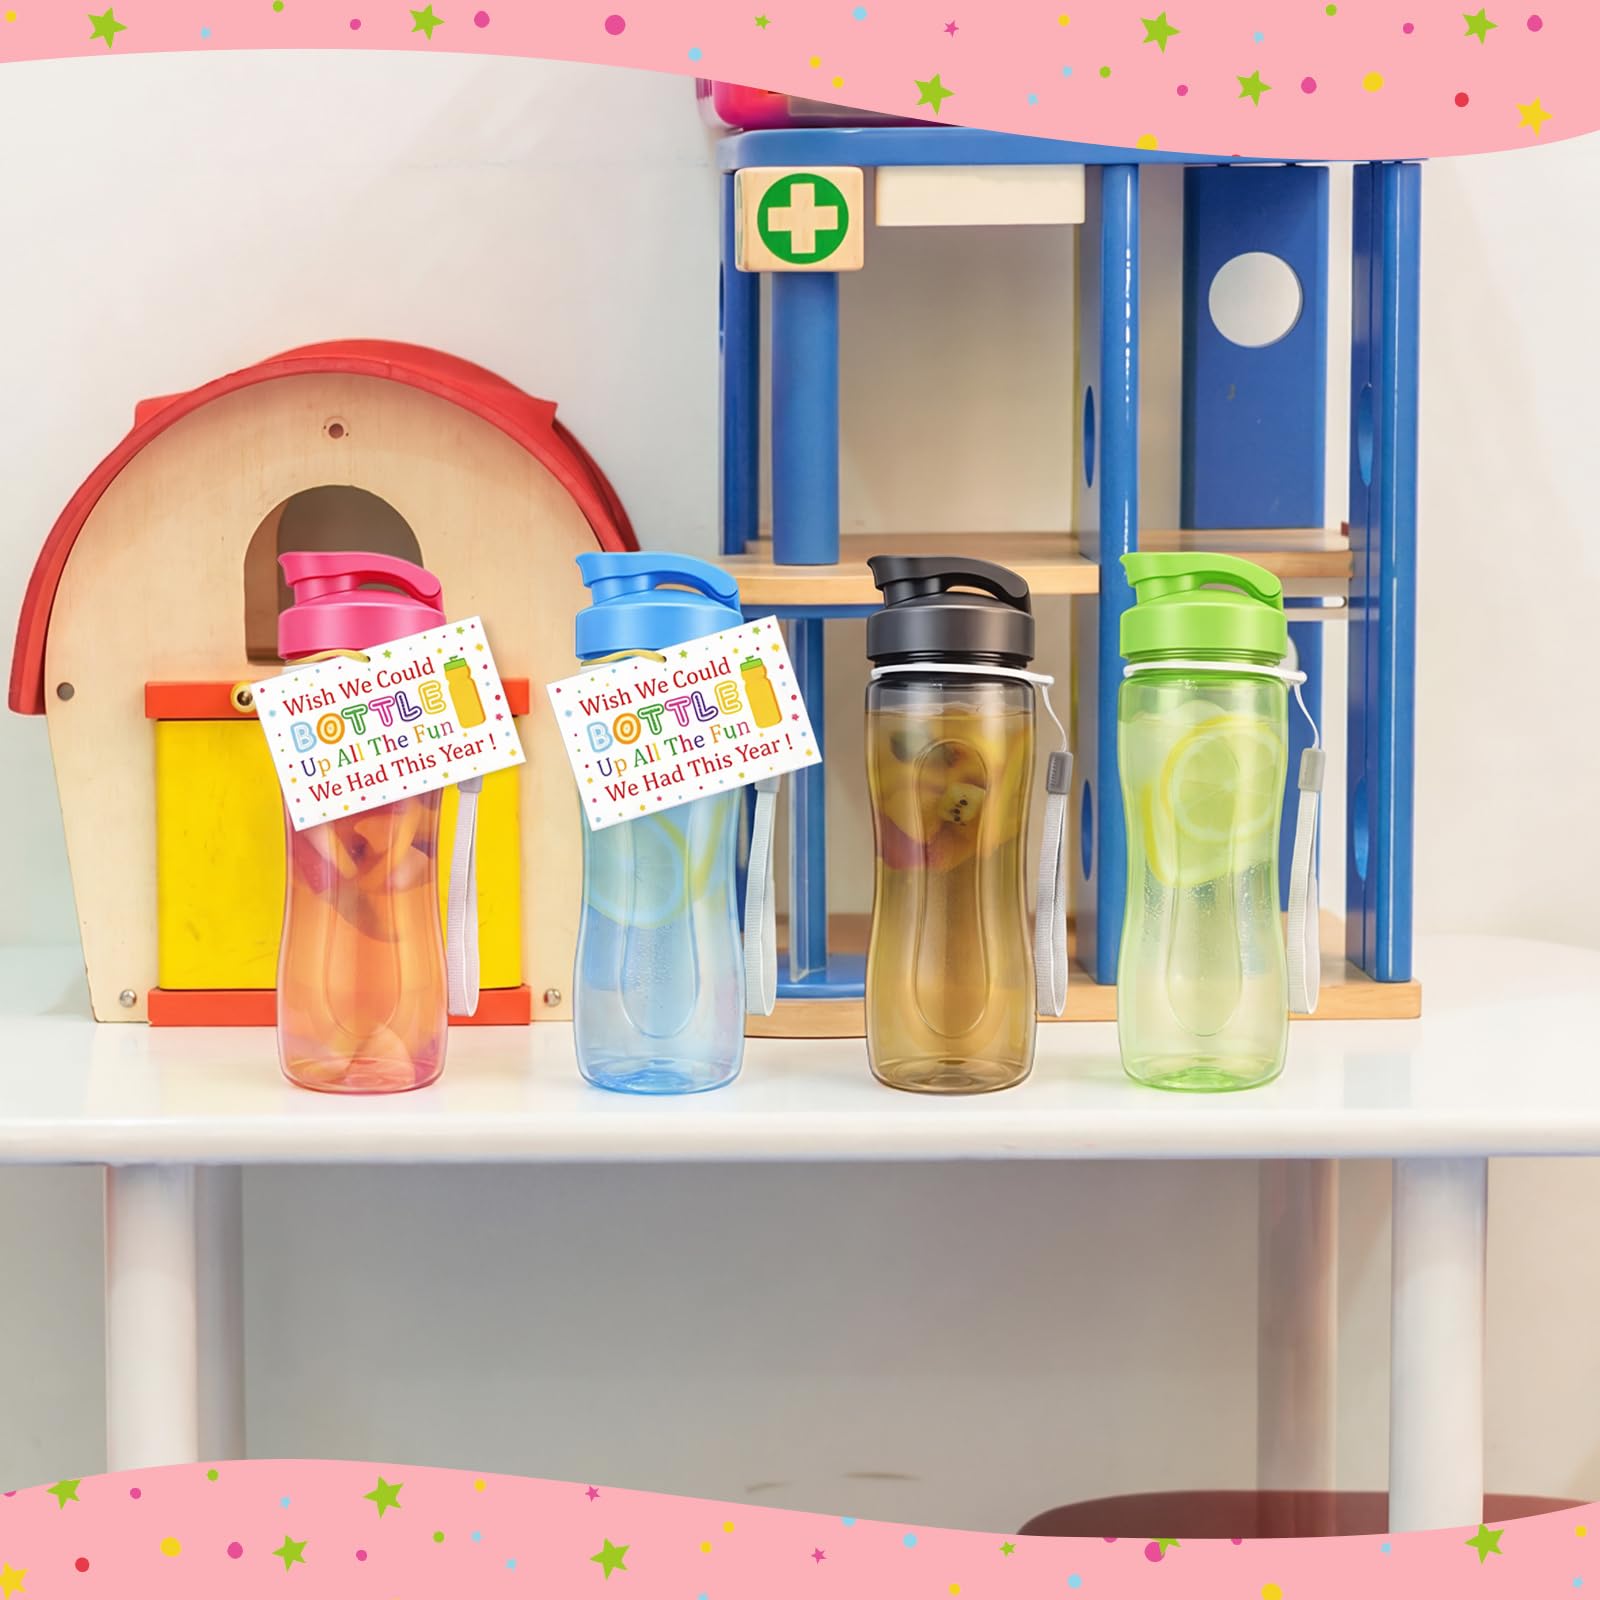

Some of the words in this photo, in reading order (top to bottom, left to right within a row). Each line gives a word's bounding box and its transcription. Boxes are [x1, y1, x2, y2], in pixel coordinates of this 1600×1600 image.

[283, 688, 337, 716] Wish
[339, 679, 372, 700] We
[376, 657, 435, 688] Could
[291, 680, 446, 753] BOTTLE
[579, 688, 633, 716] Wish
[635, 679, 668, 700] We
[673, 657, 732, 688] Could
[587, 680, 742, 753] BOTTLE
[301, 757, 331, 777] Up
[337, 744, 364, 768] All
[368, 735, 409, 756] The
[412, 720, 454, 744] Fun
[309, 781, 343, 802] We
[347, 766, 389, 791] Had
[391, 753, 436, 777] This
[439, 741, 484, 762] Year
[597, 757, 627, 777] Up
[633, 744, 660, 768] All
[664, 735, 705, 756] The
[709, 720, 750, 744] Fun
[605, 781, 639, 802] We
[643, 766, 685, 791] Had
[687, 753, 732, 777] This
[735, 741, 780, 762] Year
